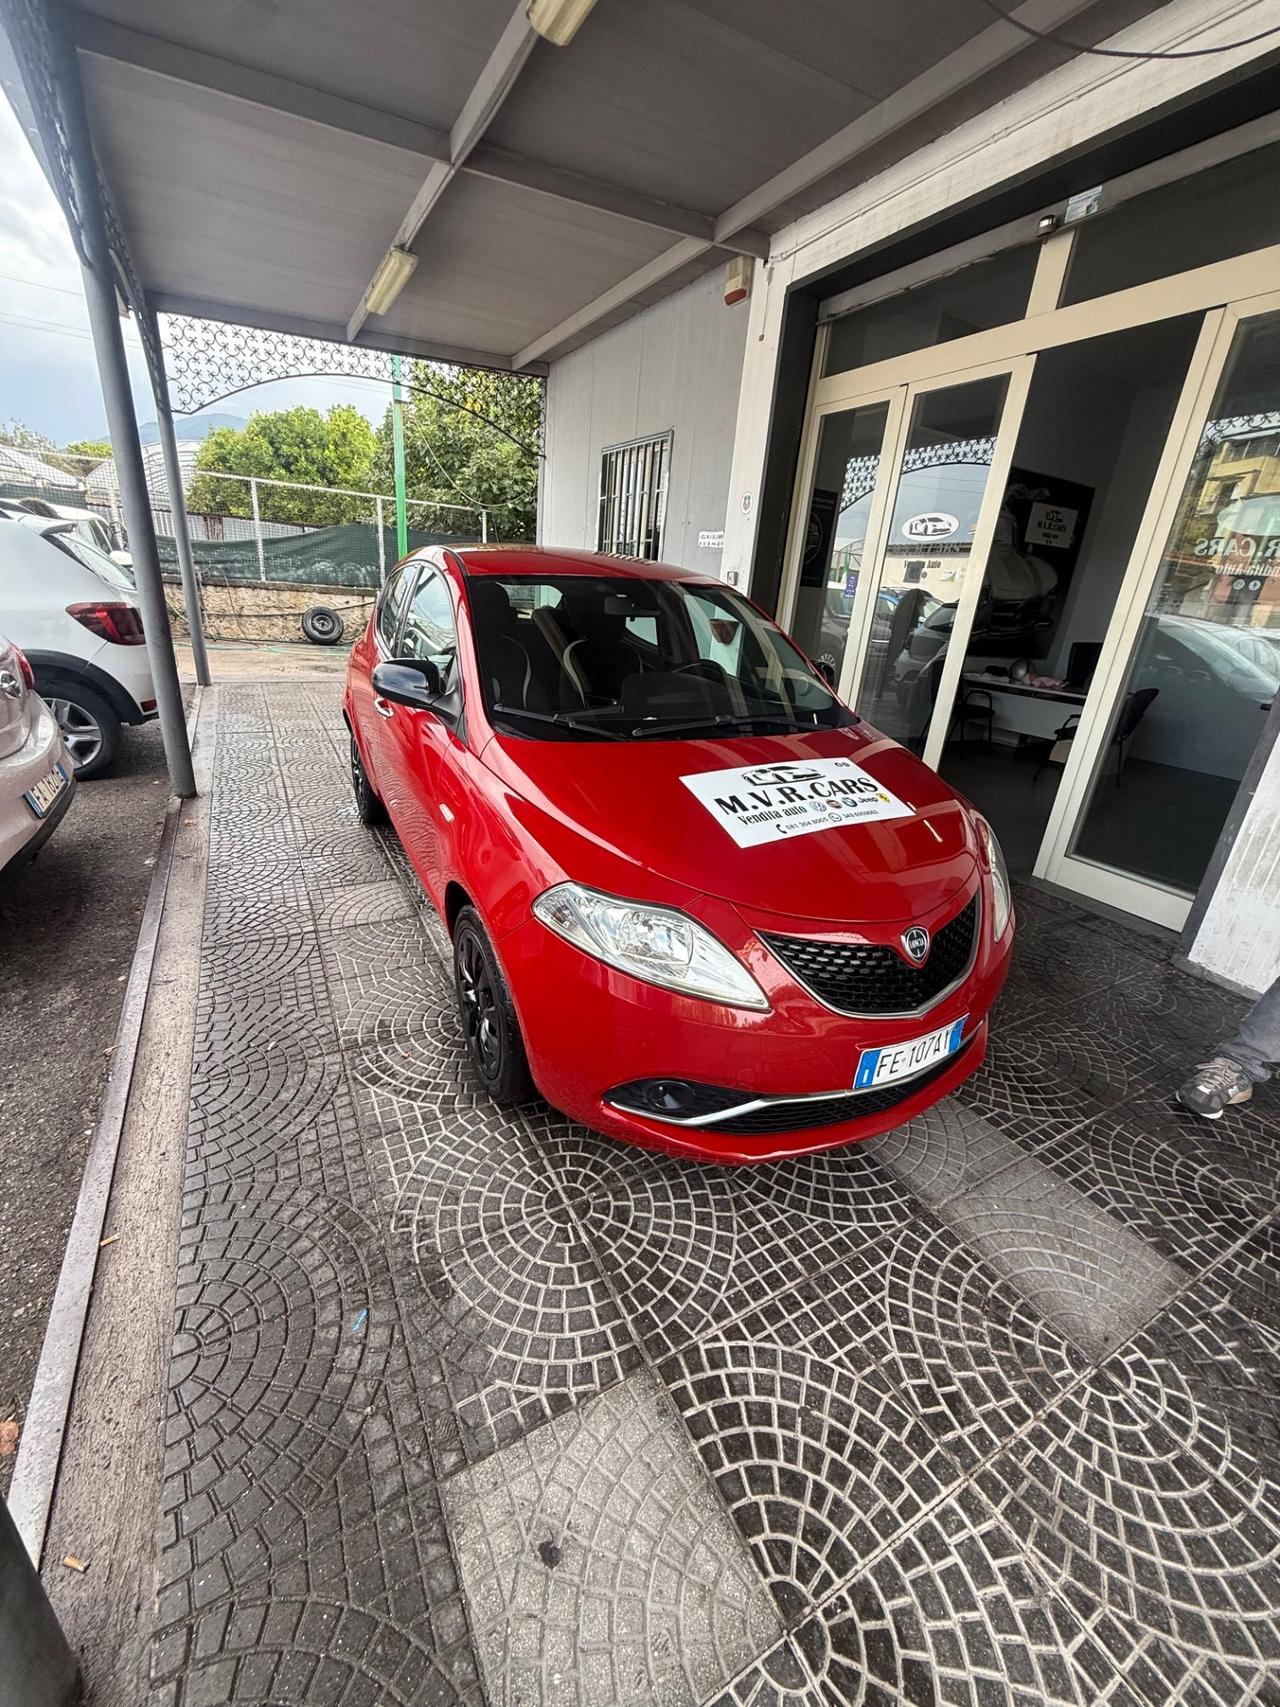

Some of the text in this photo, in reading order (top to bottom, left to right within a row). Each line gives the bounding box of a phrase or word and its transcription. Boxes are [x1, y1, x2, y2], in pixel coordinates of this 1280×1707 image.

[714, 777, 879, 815] M.V.R.CARS
[737, 805, 808, 826] Vendita auto
[877, 1050, 904, 1078] FE
